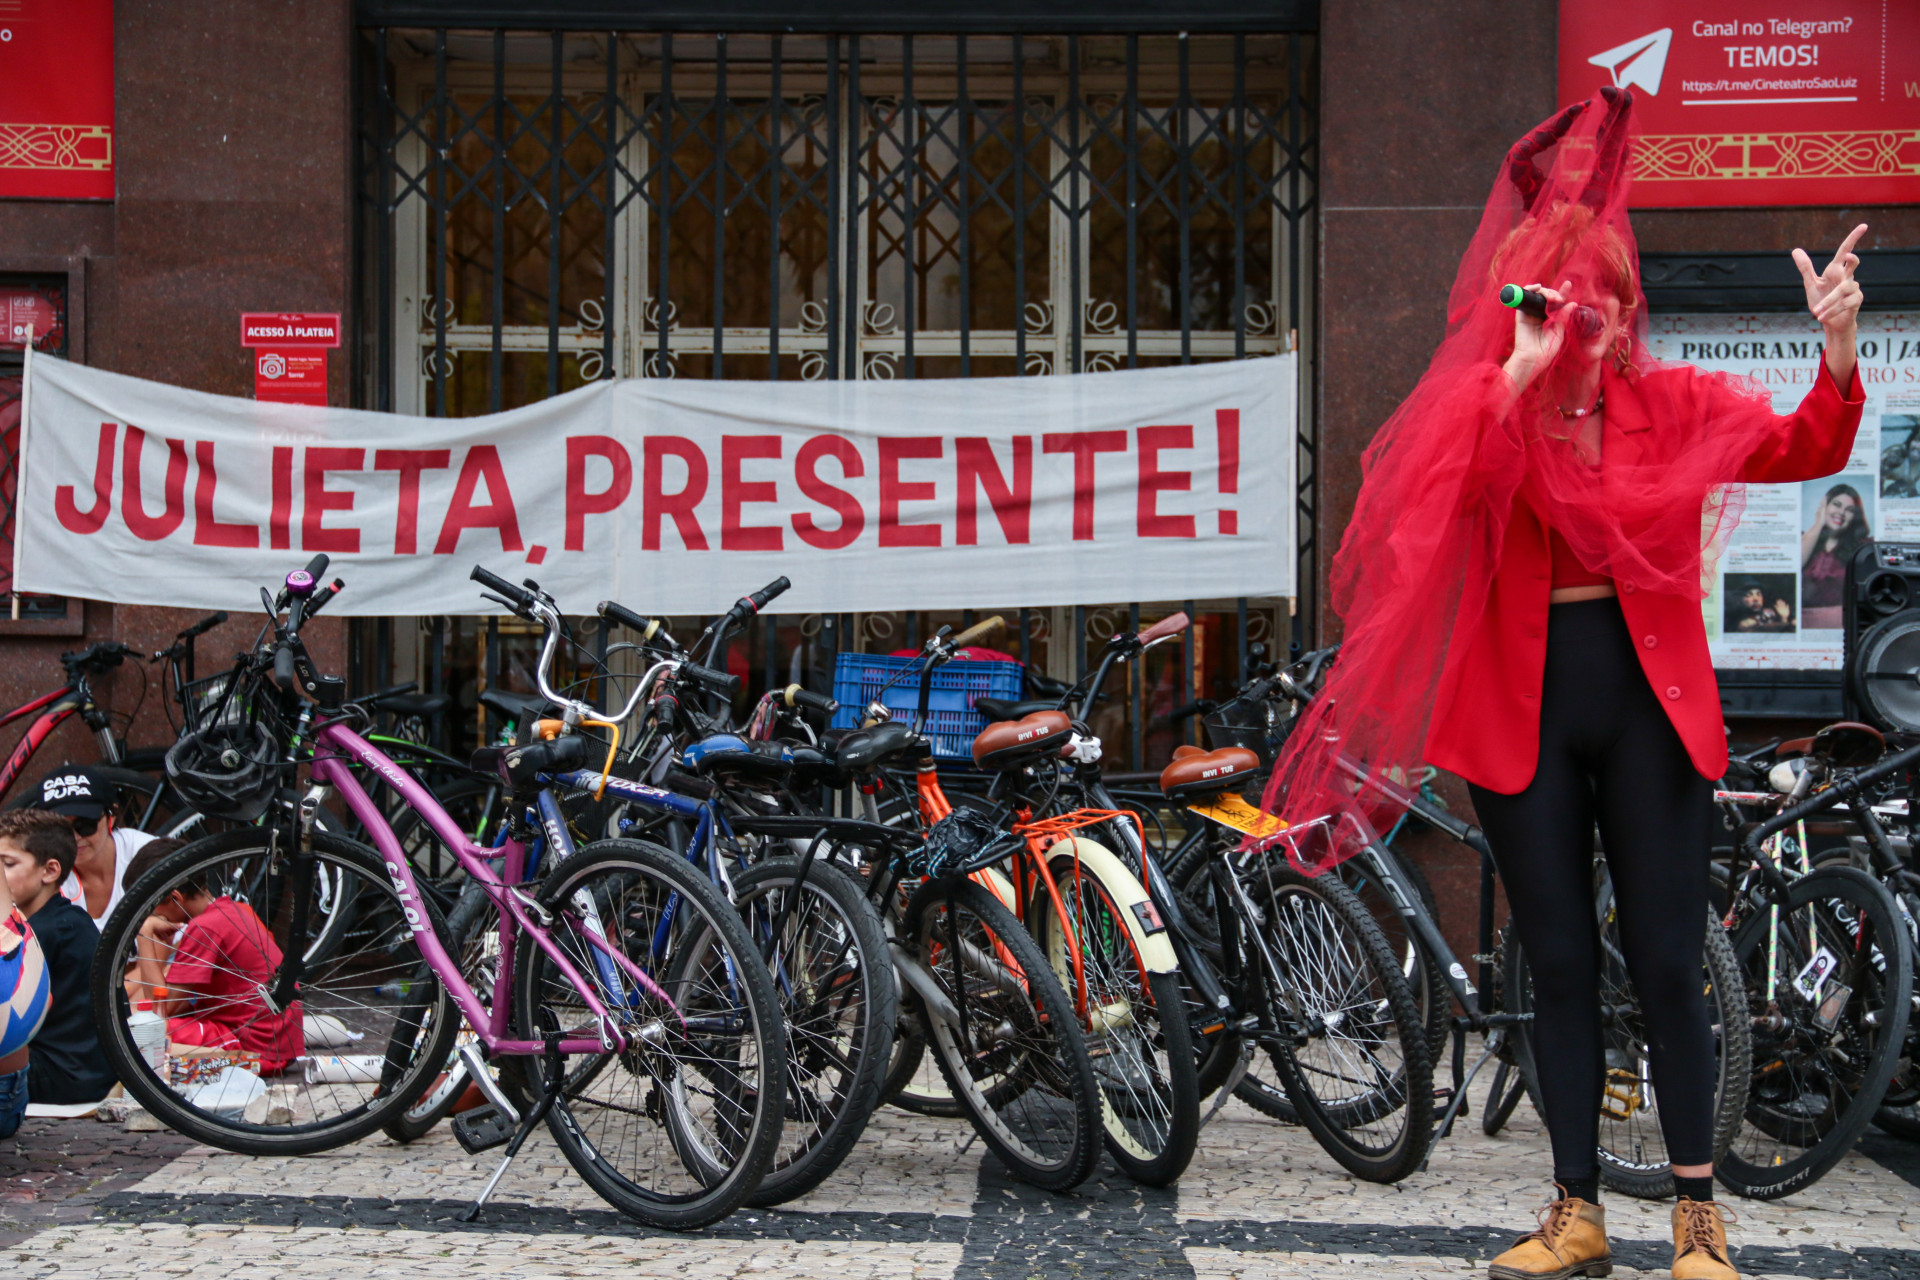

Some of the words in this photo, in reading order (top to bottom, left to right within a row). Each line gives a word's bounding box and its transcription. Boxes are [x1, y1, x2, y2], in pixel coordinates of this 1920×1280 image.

[1692, 19, 1738, 37] Canal
[1742, 22, 1764, 36] no
[1768, 16, 1853, 39] Telegram?
[1723, 44, 1819, 68] TEMOS!
[1682, 76, 1858, 94] https://t.me/CineteatroSaoLuiz
[247, 326, 285, 338] ACESSO
[286, 325, 294, 337] À
[295, 327, 334, 338] PLATEIA
[1681, 340, 1878, 360] PROGRAMAO
[1750, 366, 1897, 384] CINETRO
[54, 423, 547, 564] JULIETA,
[564, 408, 1241, 553] PRESENTE!
[43, 774, 91, 790] CASA
[386, 861, 425, 932] CALOI
[1745, 1166, 1810, 1196] thickslick
